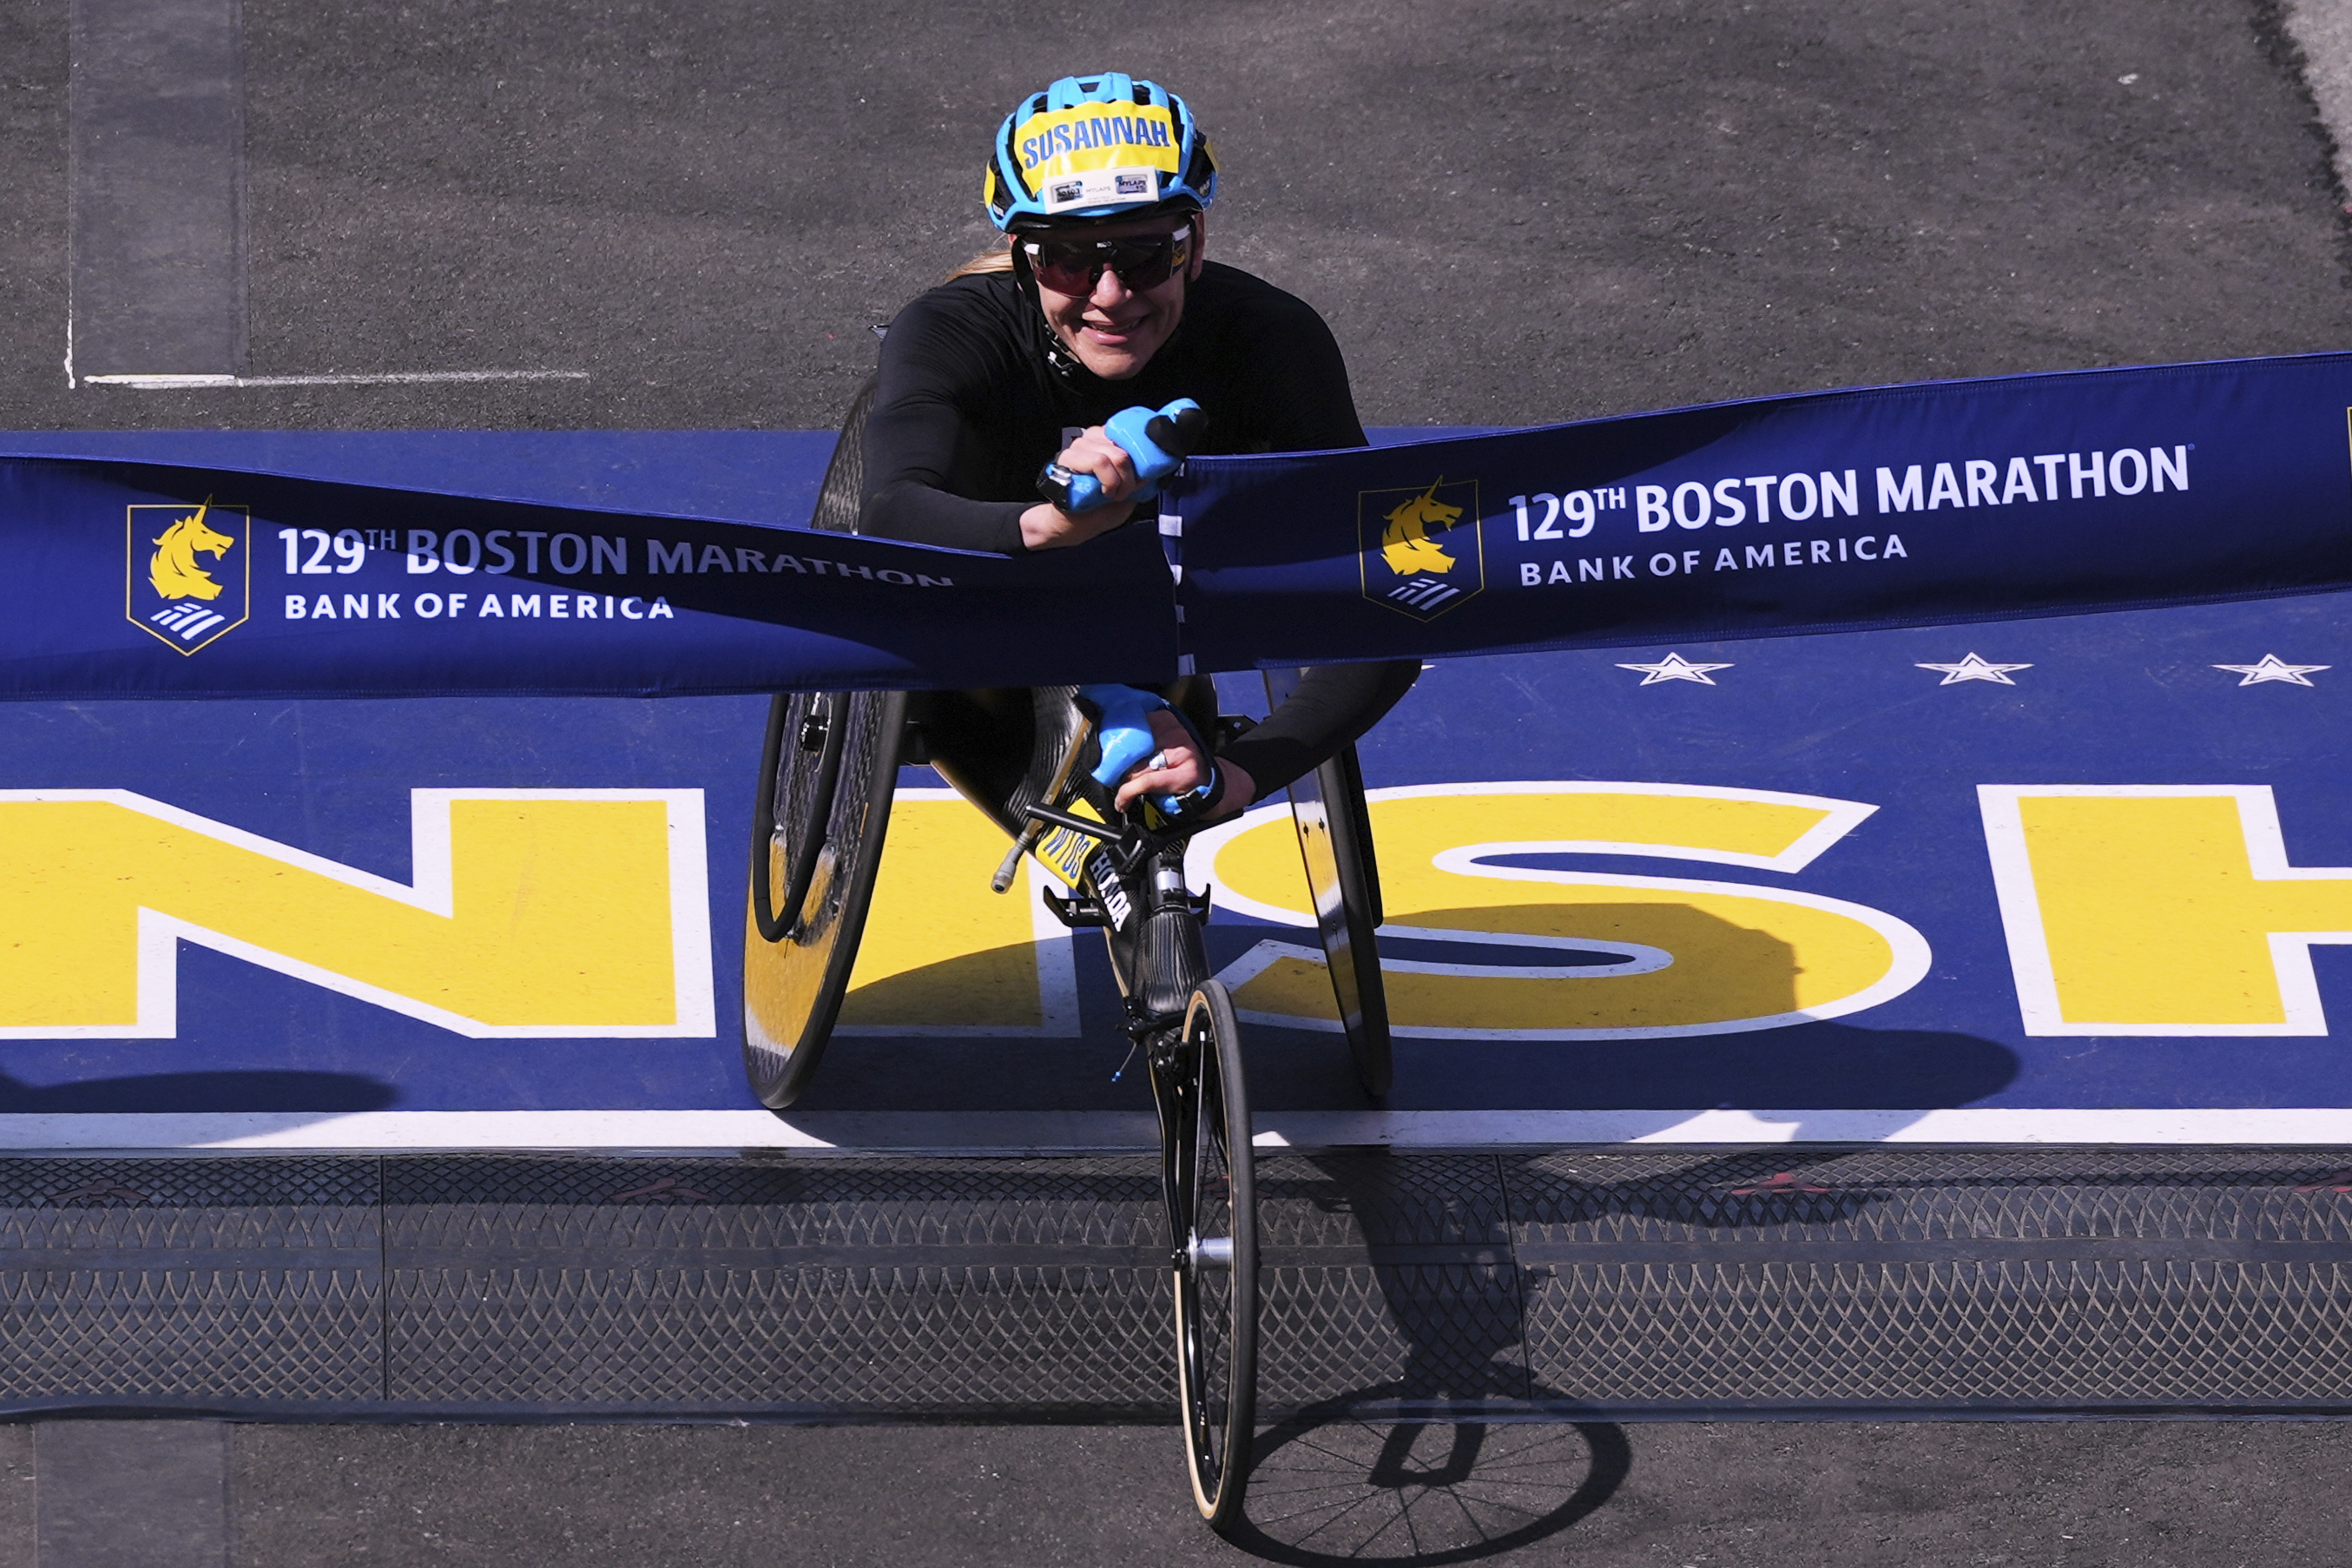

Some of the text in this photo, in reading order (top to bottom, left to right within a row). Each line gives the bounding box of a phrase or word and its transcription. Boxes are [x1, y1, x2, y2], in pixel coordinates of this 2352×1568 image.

[1023, 116, 1170, 169] SUSANNAH
[1508, 445, 2191, 542] 129TH BOSTON MARATHON
[278, 528, 954, 588] 129TH BOSTON MARATHON
[1520, 534, 1908, 587] BANK OF AMERICA
[285, 592, 675, 619] BANK OF AMERICA
[1090, 851, 1132, 932] HONDA
